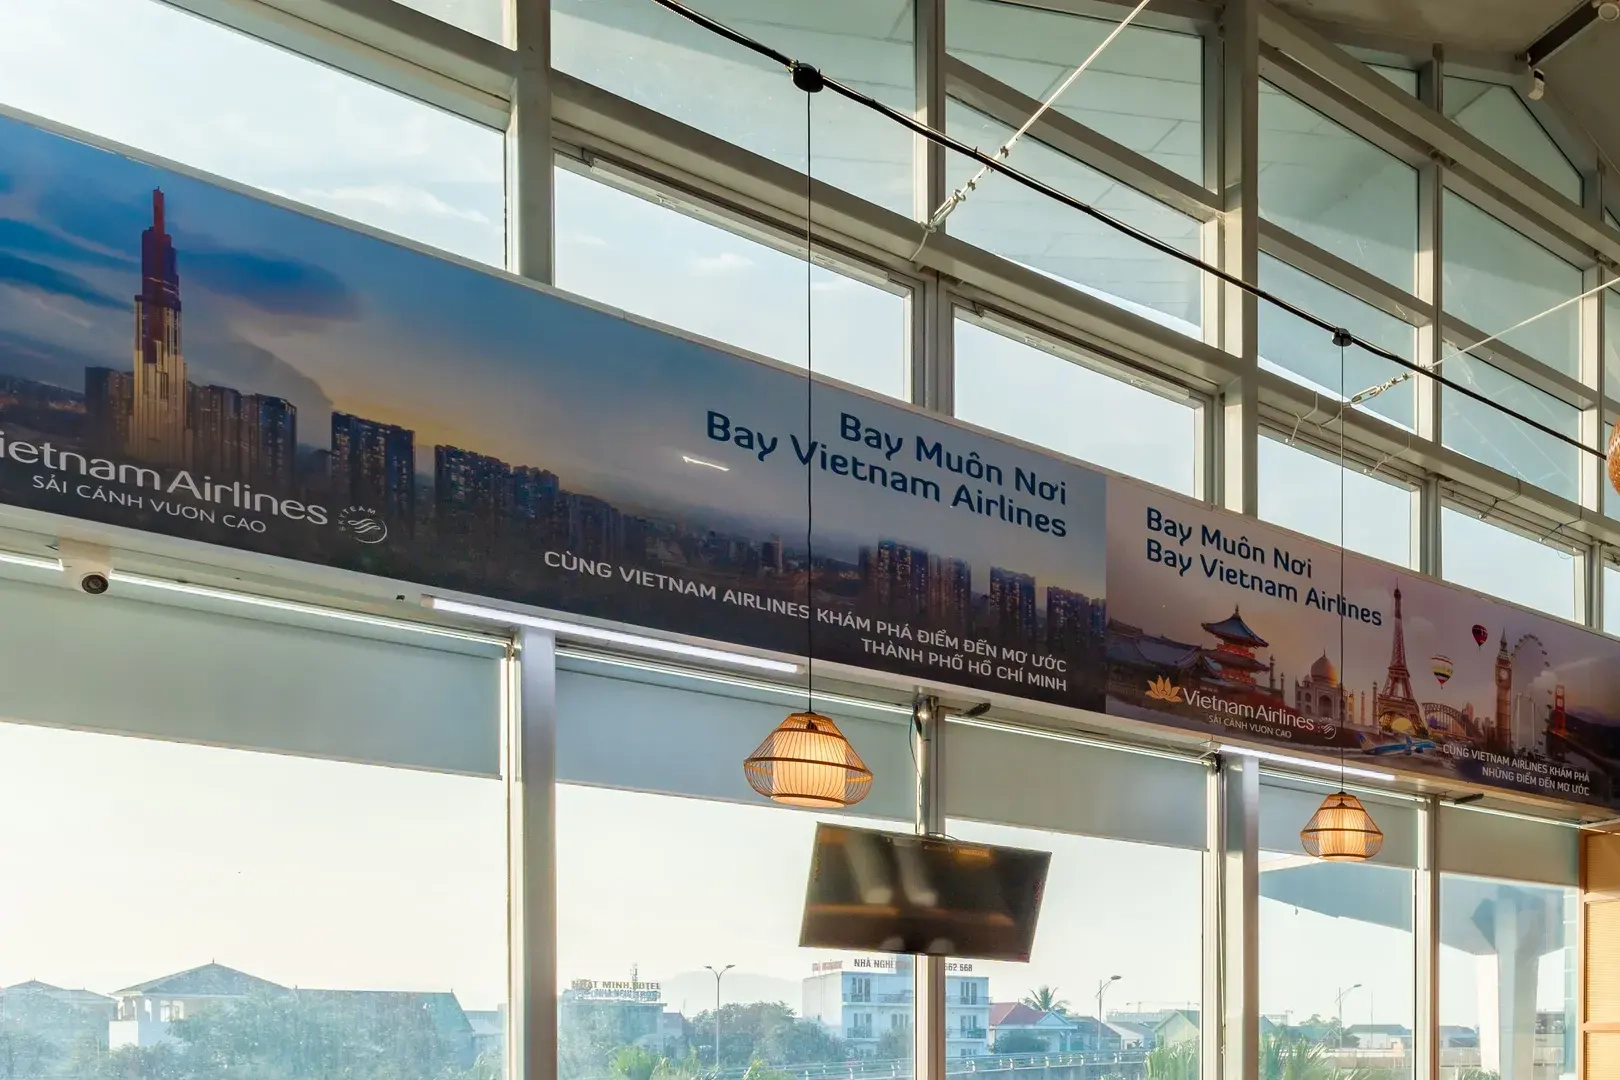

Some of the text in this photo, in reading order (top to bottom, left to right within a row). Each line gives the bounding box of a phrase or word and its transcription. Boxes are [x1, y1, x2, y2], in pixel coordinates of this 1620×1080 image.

[0, 430, 328, 525] ietnam Airlines
[706, 410, 1067, 537] Bay Vietnam Airlines
[841, 411, 1066, 505] Bay Muôn Nơi
[32, 473, 267, 533] SẢI CÁNH VƯƠN CAO
[1146, 506, 1312, 578] Bay Muôn Nơi
[543, 550, 1067, 673] CÙNG VIETNAM AIRLINES KHÁM PHÁ ĐIỂM ĐẾN MƠ ƯỚC
[1146, 538, 1383, 627] Bay Vietnam Airlines
[861, 637, 1067, 692] THÀNH PHỐ HỒ CHÍ MINH
[1182, 687, 1255, 719] Vietnam
[1255, 705, 1314, 732] Airlines
[1274, 728, 1292, 739] CAO
[1442, 742, 1590, 783] CÙNG VIETNAM AIRLINES KHÁM PHÁ
[853, 956, 872, 968] NHÀ
